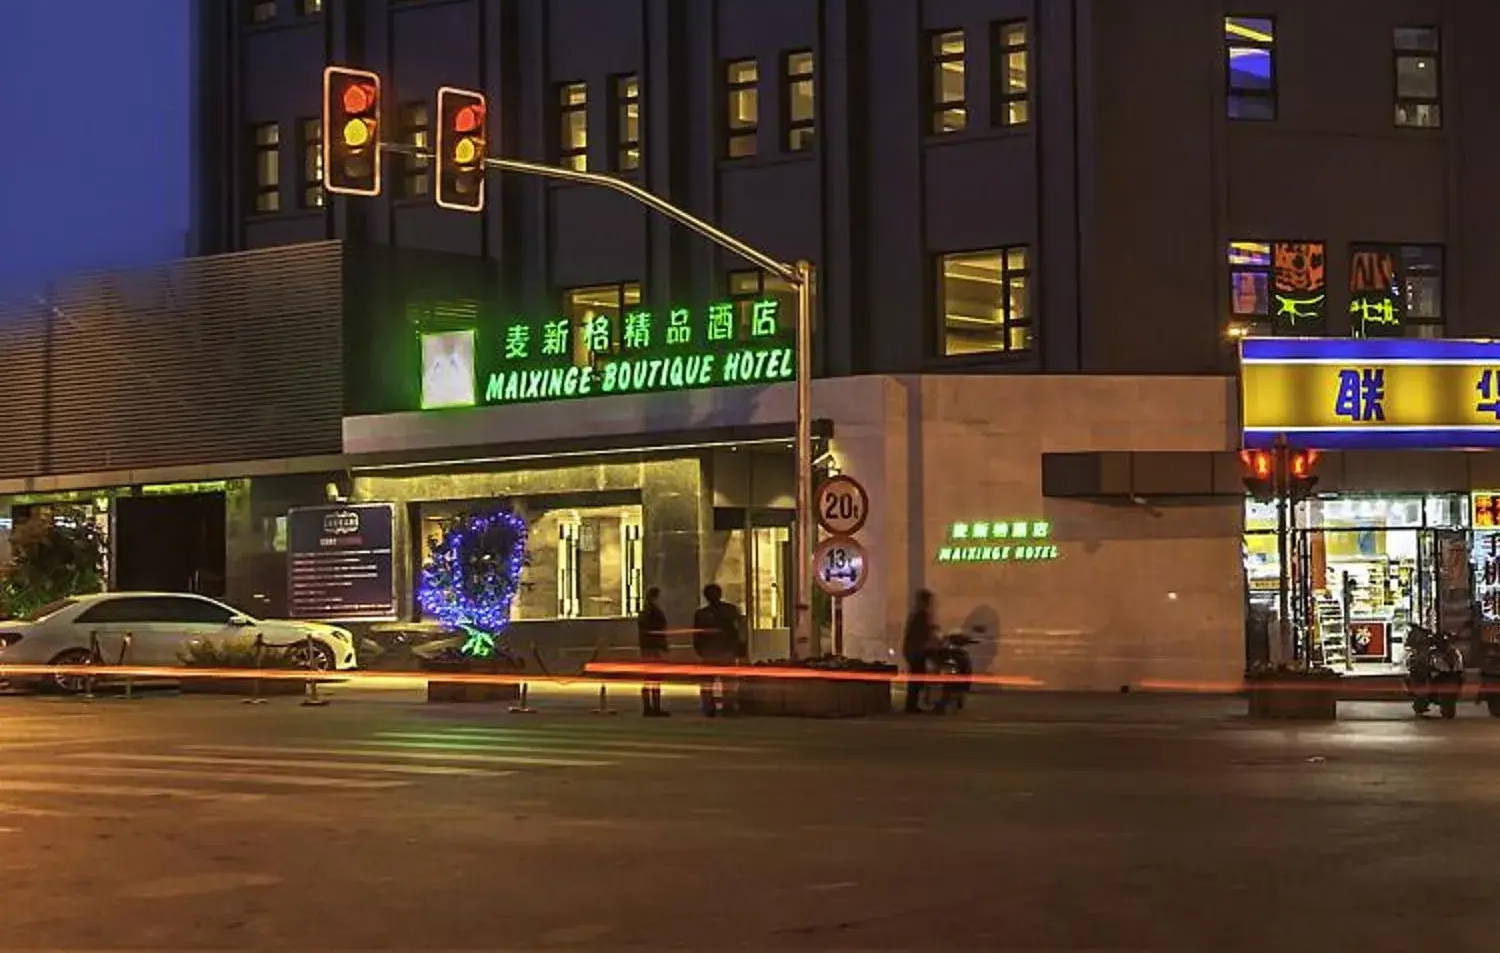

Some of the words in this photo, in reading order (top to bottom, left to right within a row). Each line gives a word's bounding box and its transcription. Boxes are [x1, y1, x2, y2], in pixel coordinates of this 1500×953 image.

[505, 300, 776, 359] 麦新格精品酒店
[486, 368, 591, 401] MAIXINGE
[602, 355, 713, 392] BOUTIQUE
[723, 348, 793, 380] HOTEL
